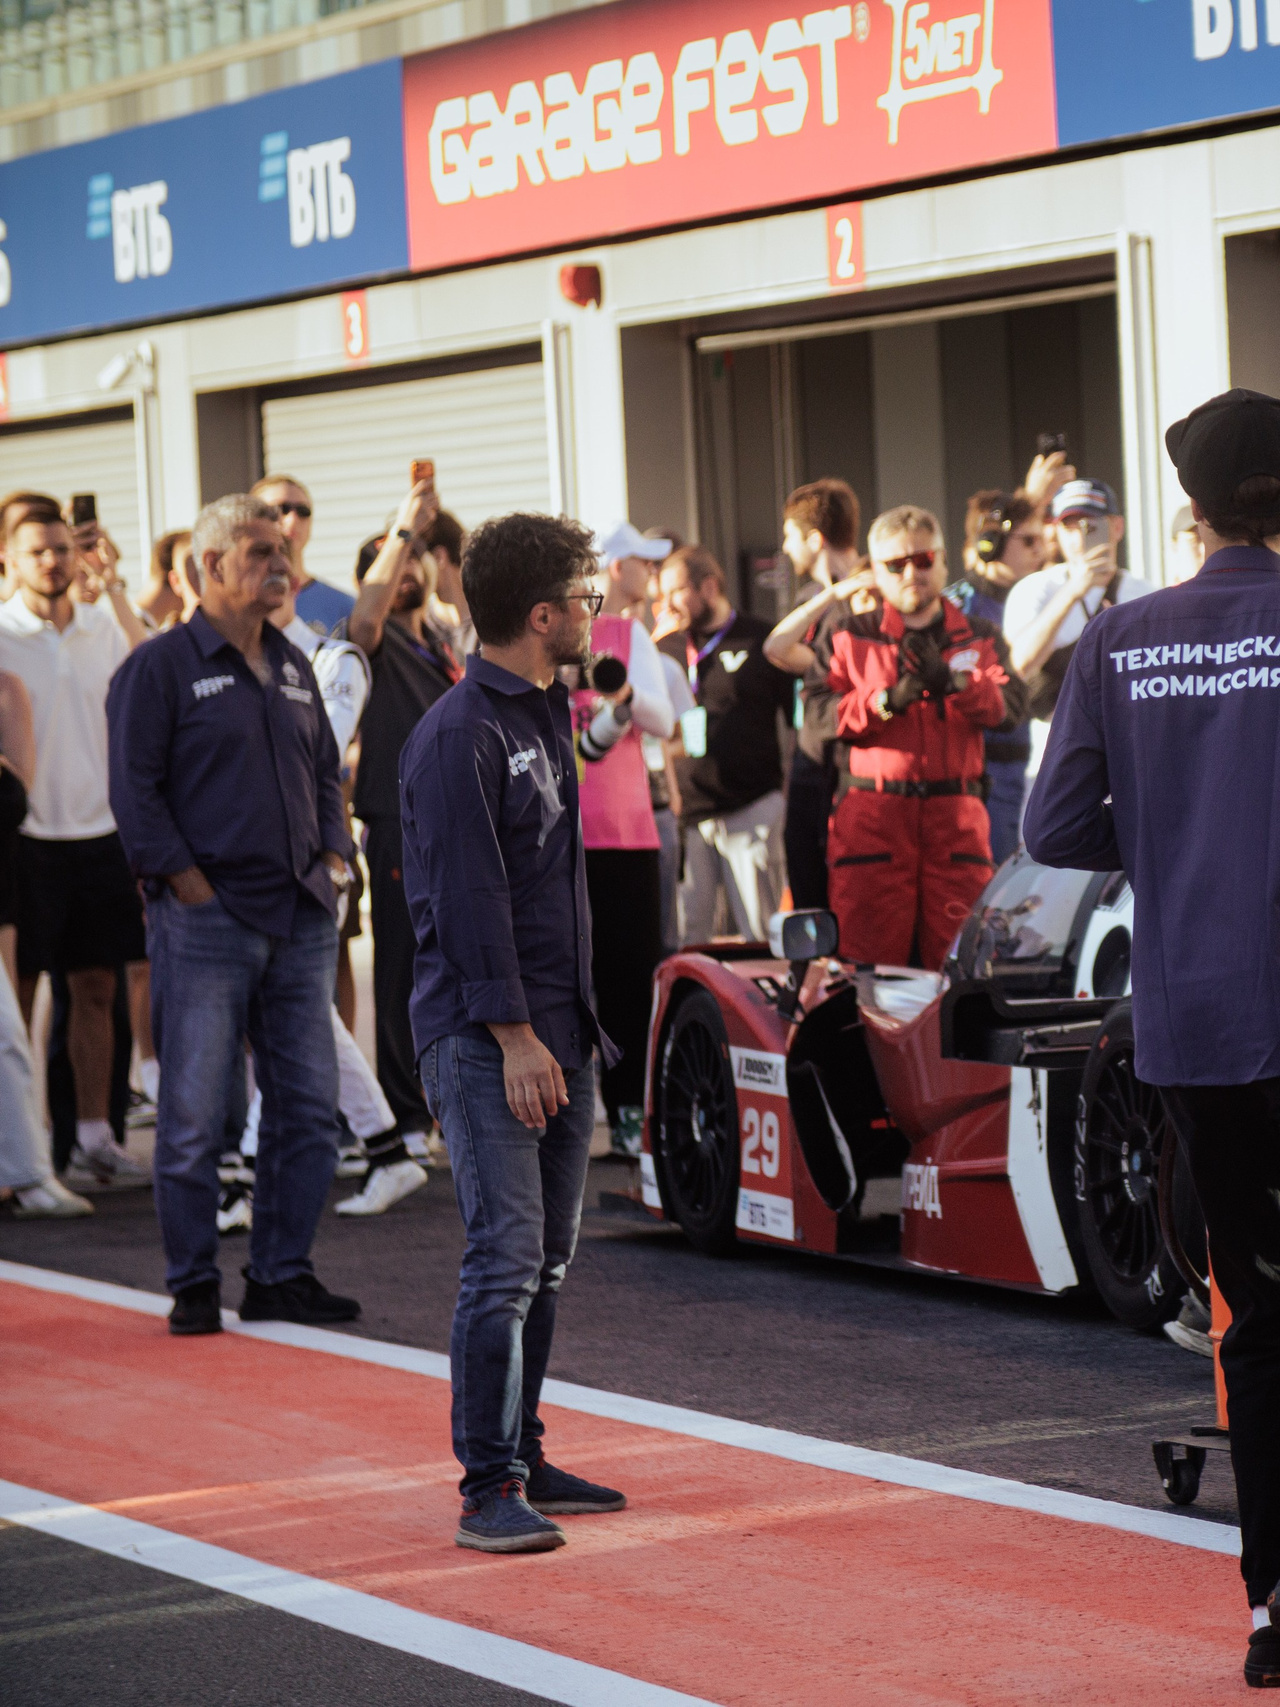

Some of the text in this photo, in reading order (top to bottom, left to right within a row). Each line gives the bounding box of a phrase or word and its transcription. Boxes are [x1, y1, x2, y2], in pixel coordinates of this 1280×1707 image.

[287, 136, 356, 248] ВТБ
[112, 180, 173, 283] ВТБ
[833, 217, 855, 279] 2
[346, 301, 364, 356] 3
[741, 1107, 781, 1179] 29
